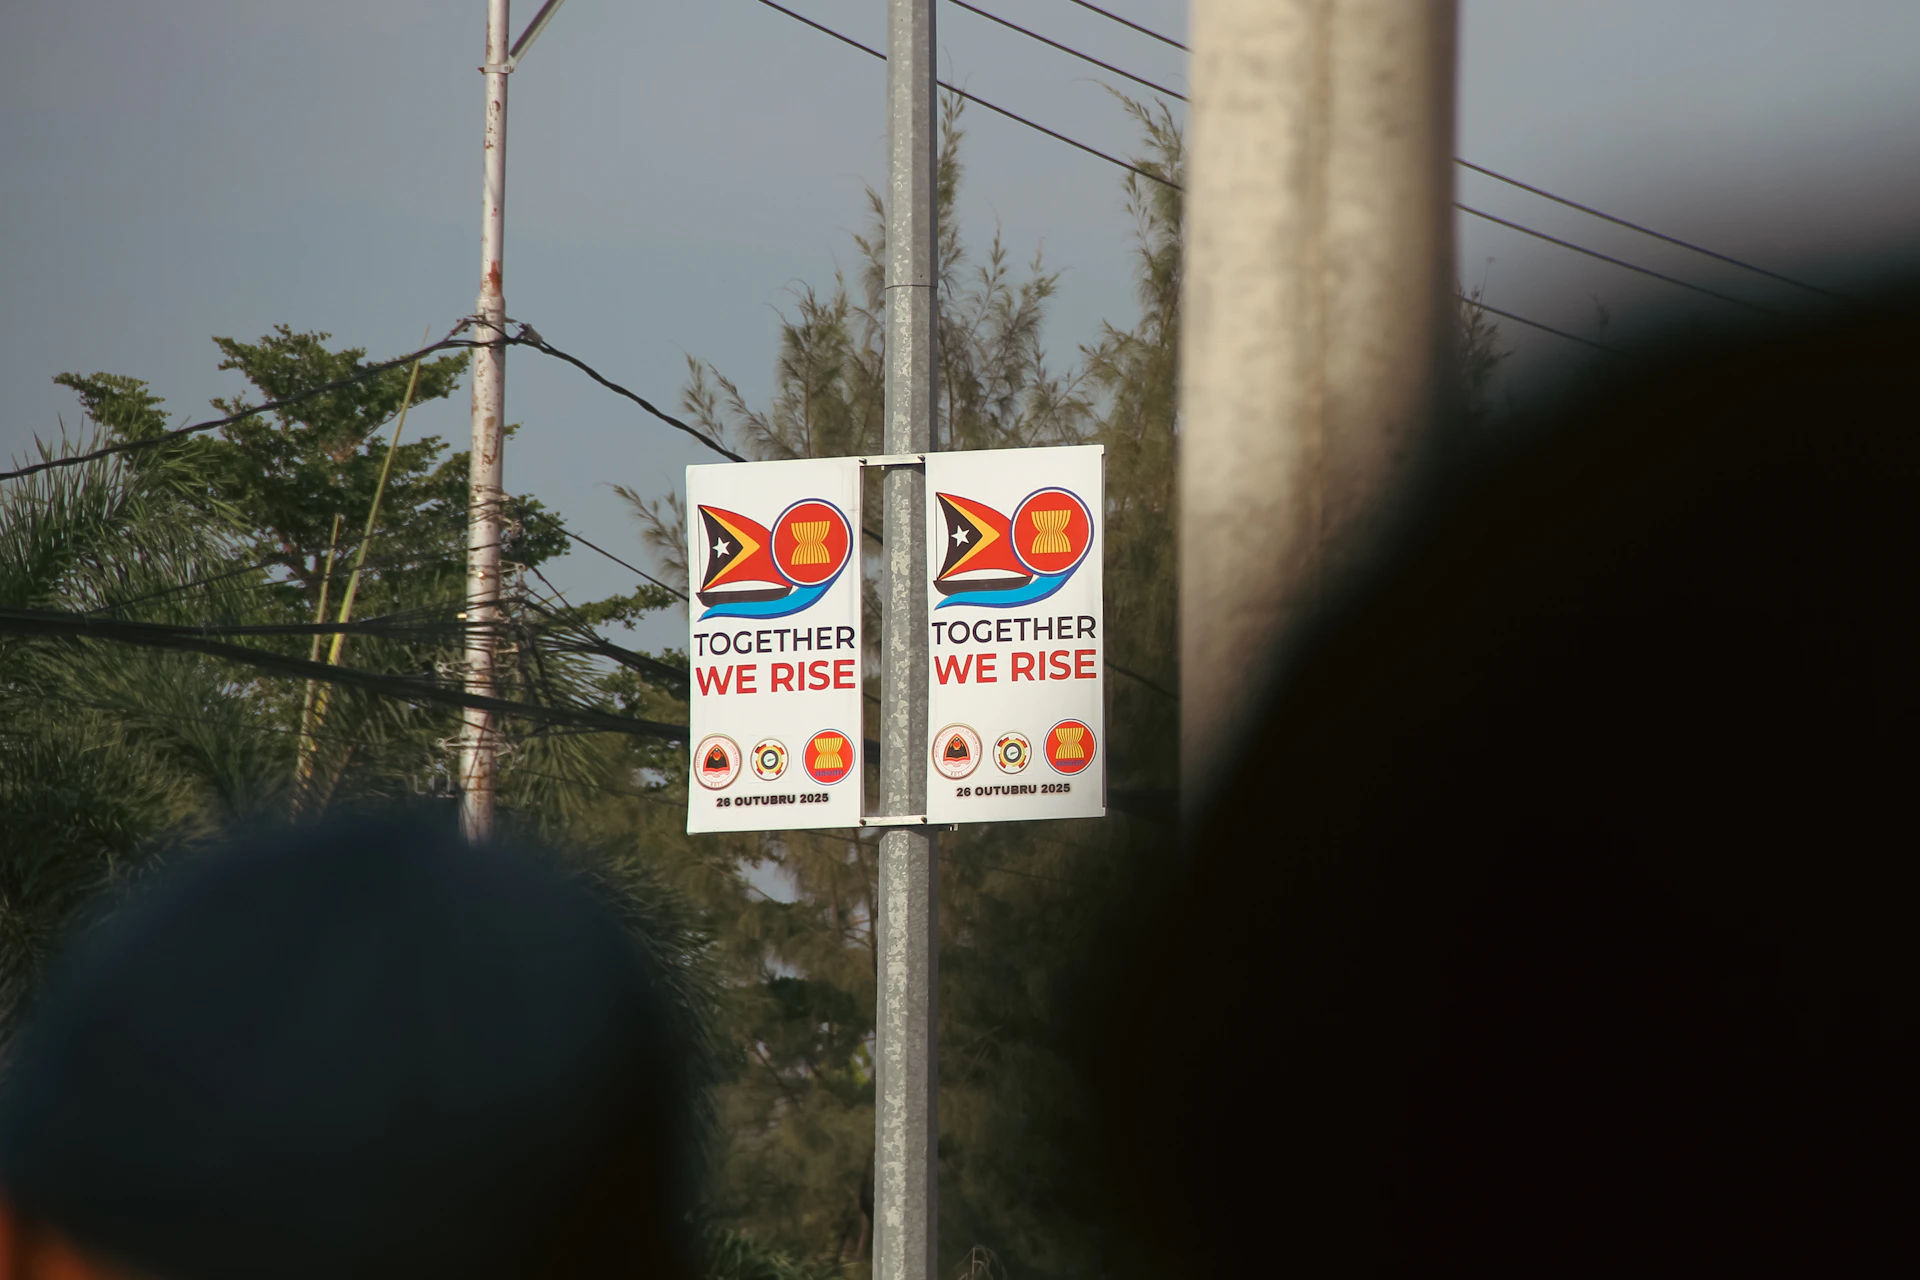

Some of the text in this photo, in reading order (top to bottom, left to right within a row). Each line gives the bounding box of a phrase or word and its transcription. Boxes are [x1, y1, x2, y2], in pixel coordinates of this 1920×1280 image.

[693, 626, 855, 656] TOGETHER
[931, 615, 1097, 645] TOGETHER
[695, 659, 856, 696] WE RISE
[934, 649, 1097, 685] WE RISE
[716, 793, 829, 807] 26 OUTUBRU 2025
[956, 783, 1071, 797] 26 OUTUBRU 2025
